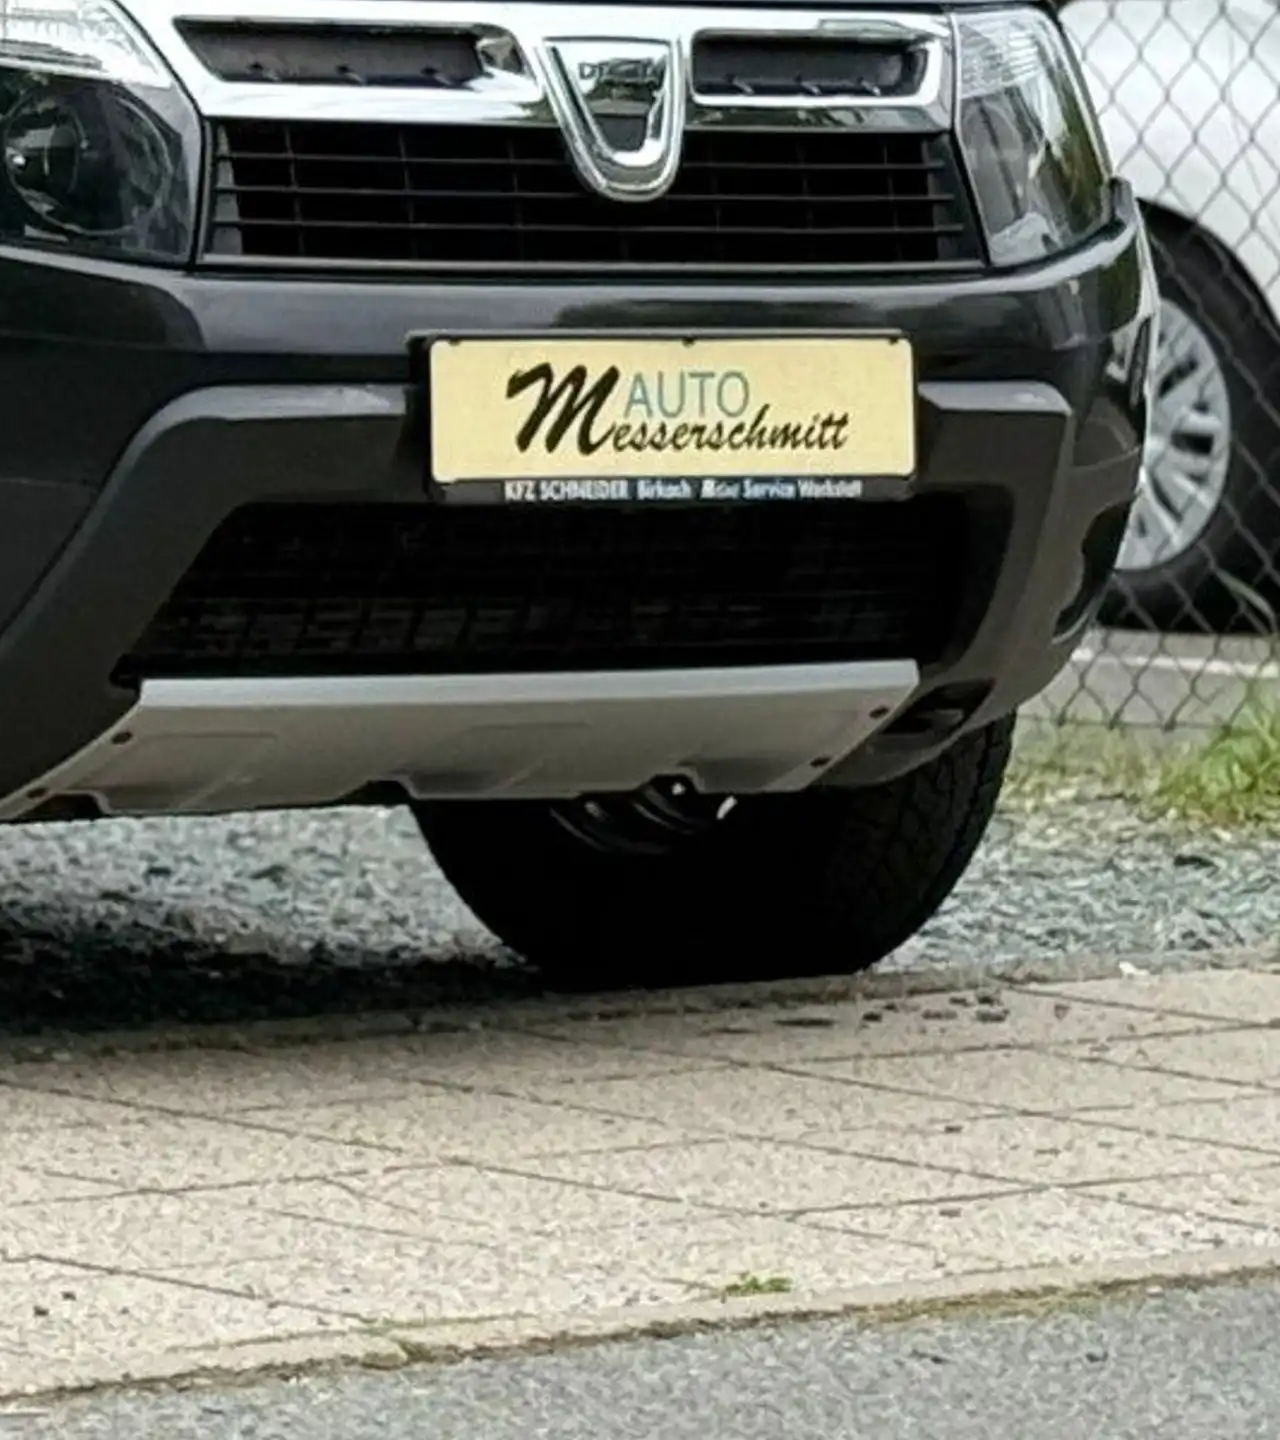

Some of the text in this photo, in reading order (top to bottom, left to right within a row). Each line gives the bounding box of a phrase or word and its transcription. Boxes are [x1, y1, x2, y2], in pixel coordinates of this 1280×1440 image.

[505, 361, 850, 457] Messerschmitt
[622, 369, 751, 420] AUTO
[504, 479, 537, 501] KFZ
